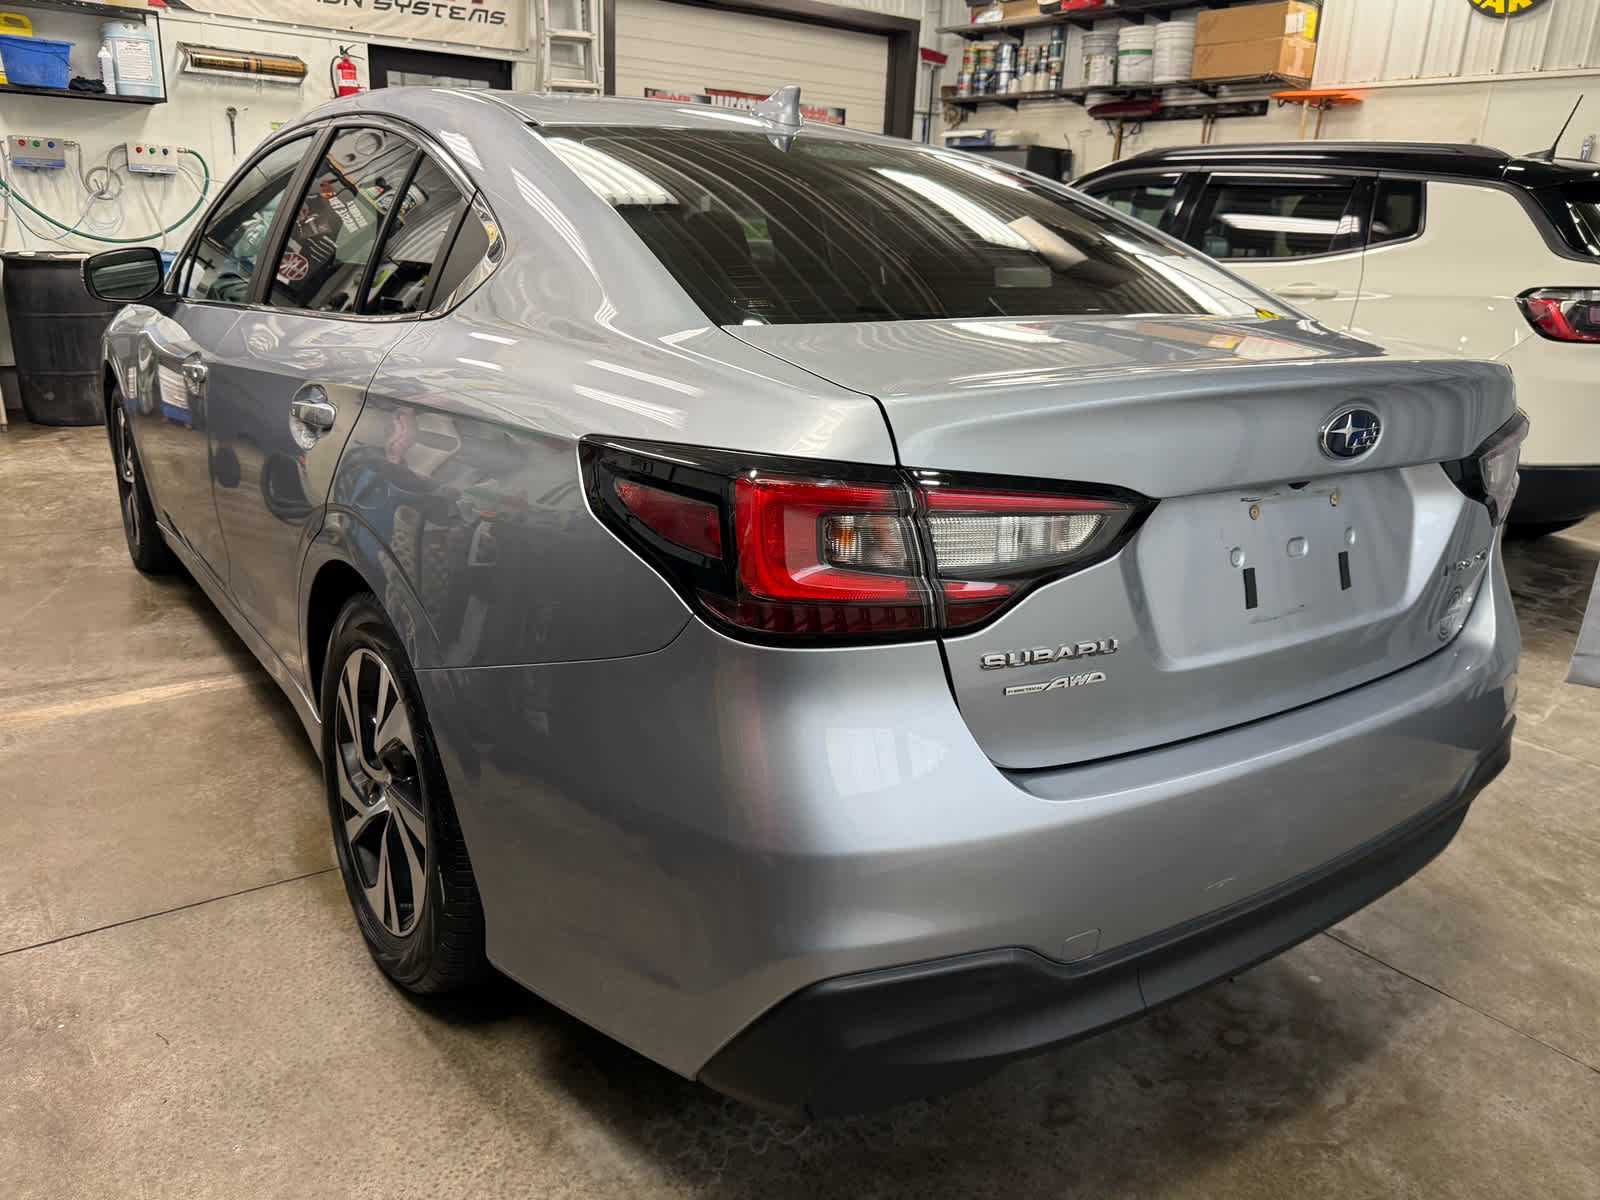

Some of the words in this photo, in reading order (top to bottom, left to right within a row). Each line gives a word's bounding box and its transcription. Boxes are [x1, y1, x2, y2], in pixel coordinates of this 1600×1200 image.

[372, 0, 507, 25] SYSTEMS
[980, 638, 1119, 671] SUBARU
[1042, 670, 1107, 690] AWD
